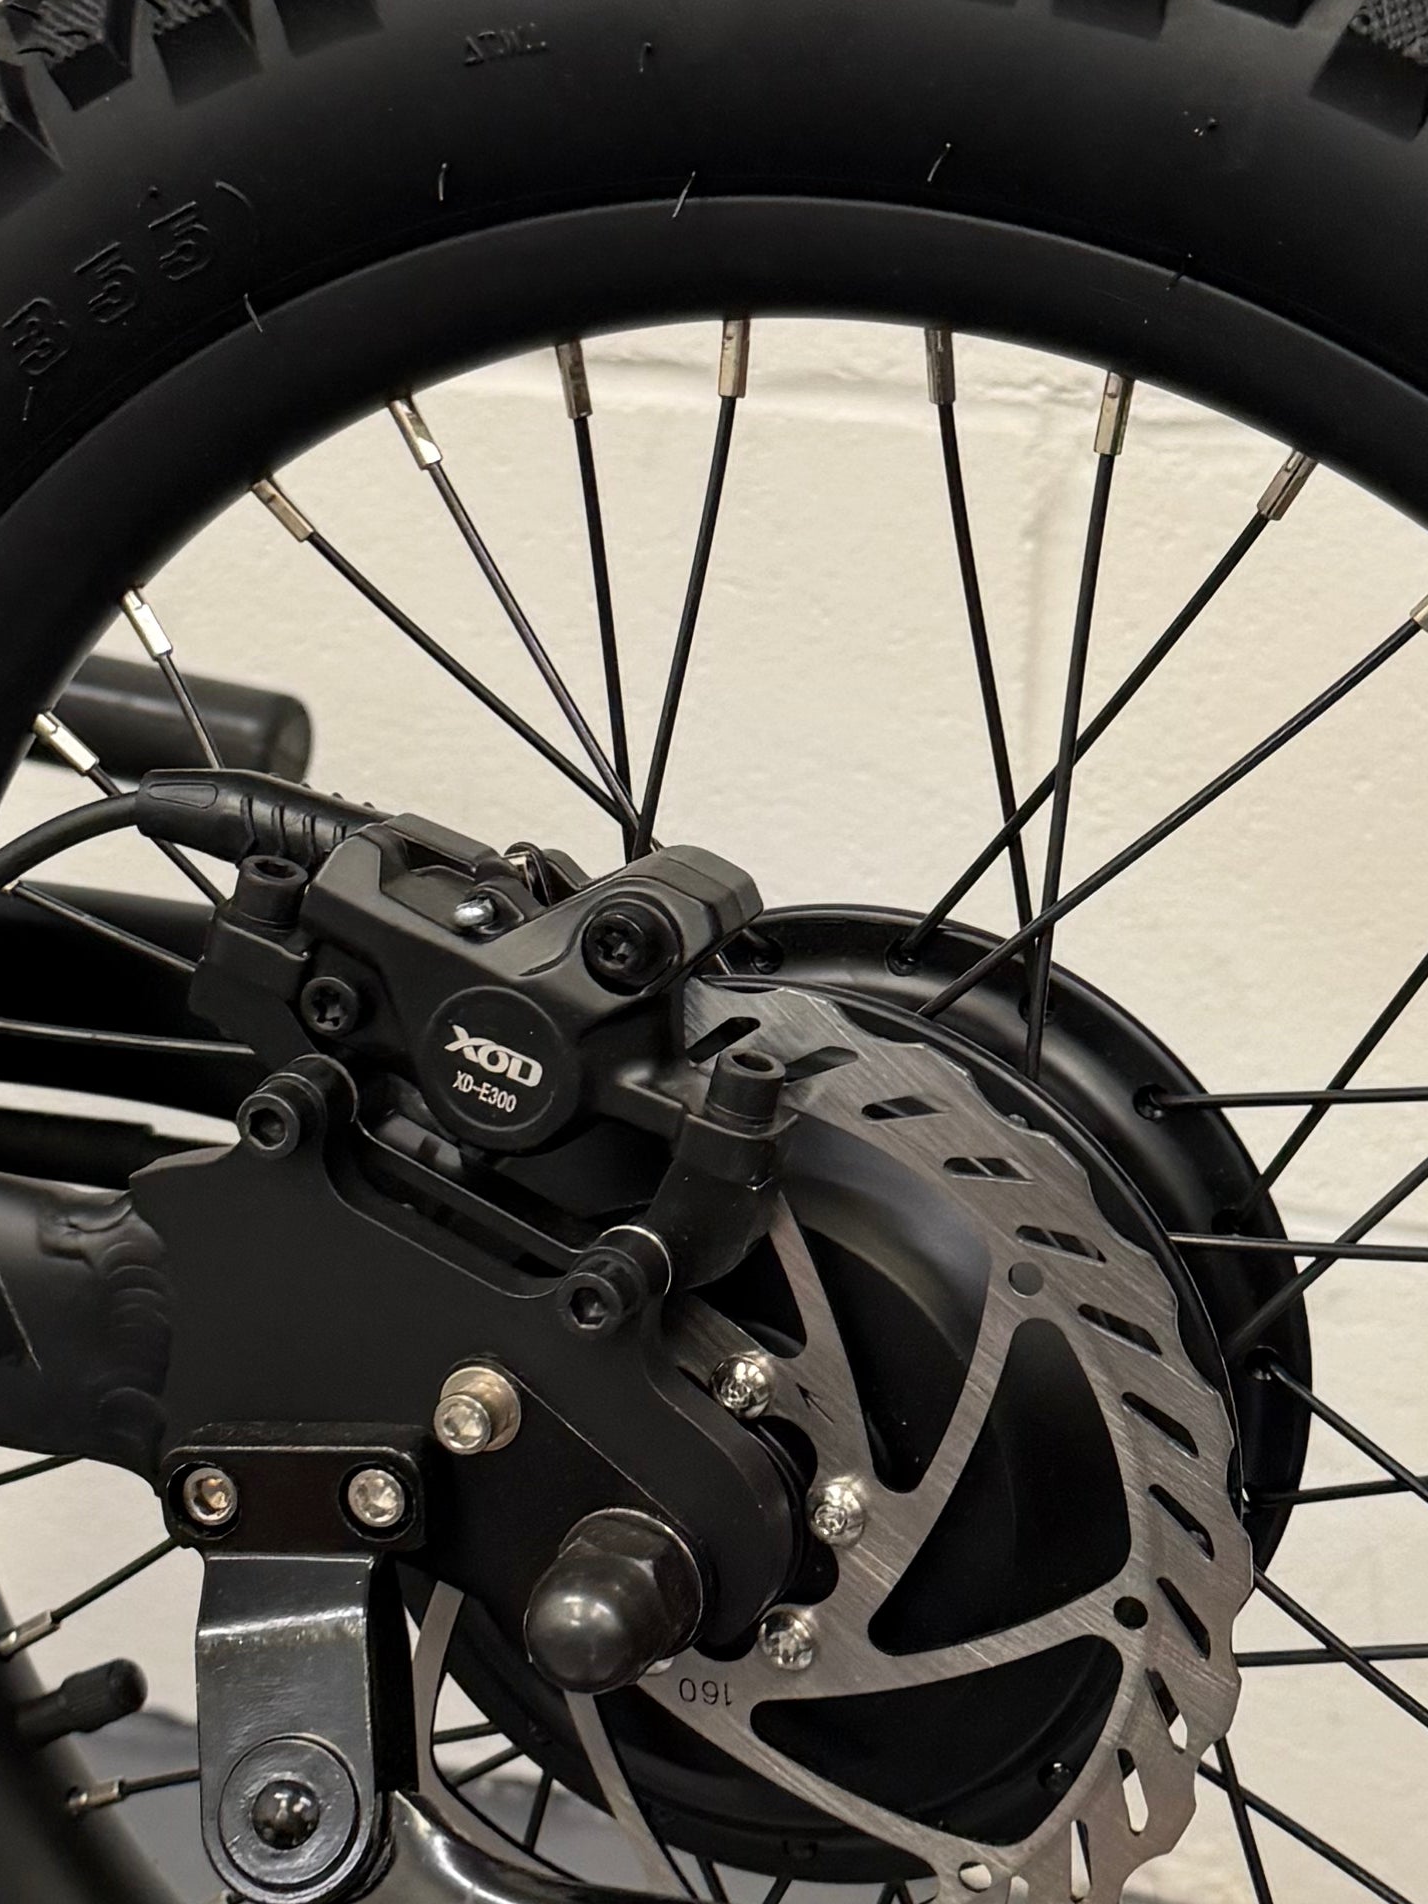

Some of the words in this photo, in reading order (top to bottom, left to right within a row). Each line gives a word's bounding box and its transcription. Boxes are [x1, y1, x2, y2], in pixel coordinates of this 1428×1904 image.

[444, 1024, 543, 1087] XOD
[452, 1070, 517, 1113] XD-E300
[678, 1676, 733, 1707] 160
